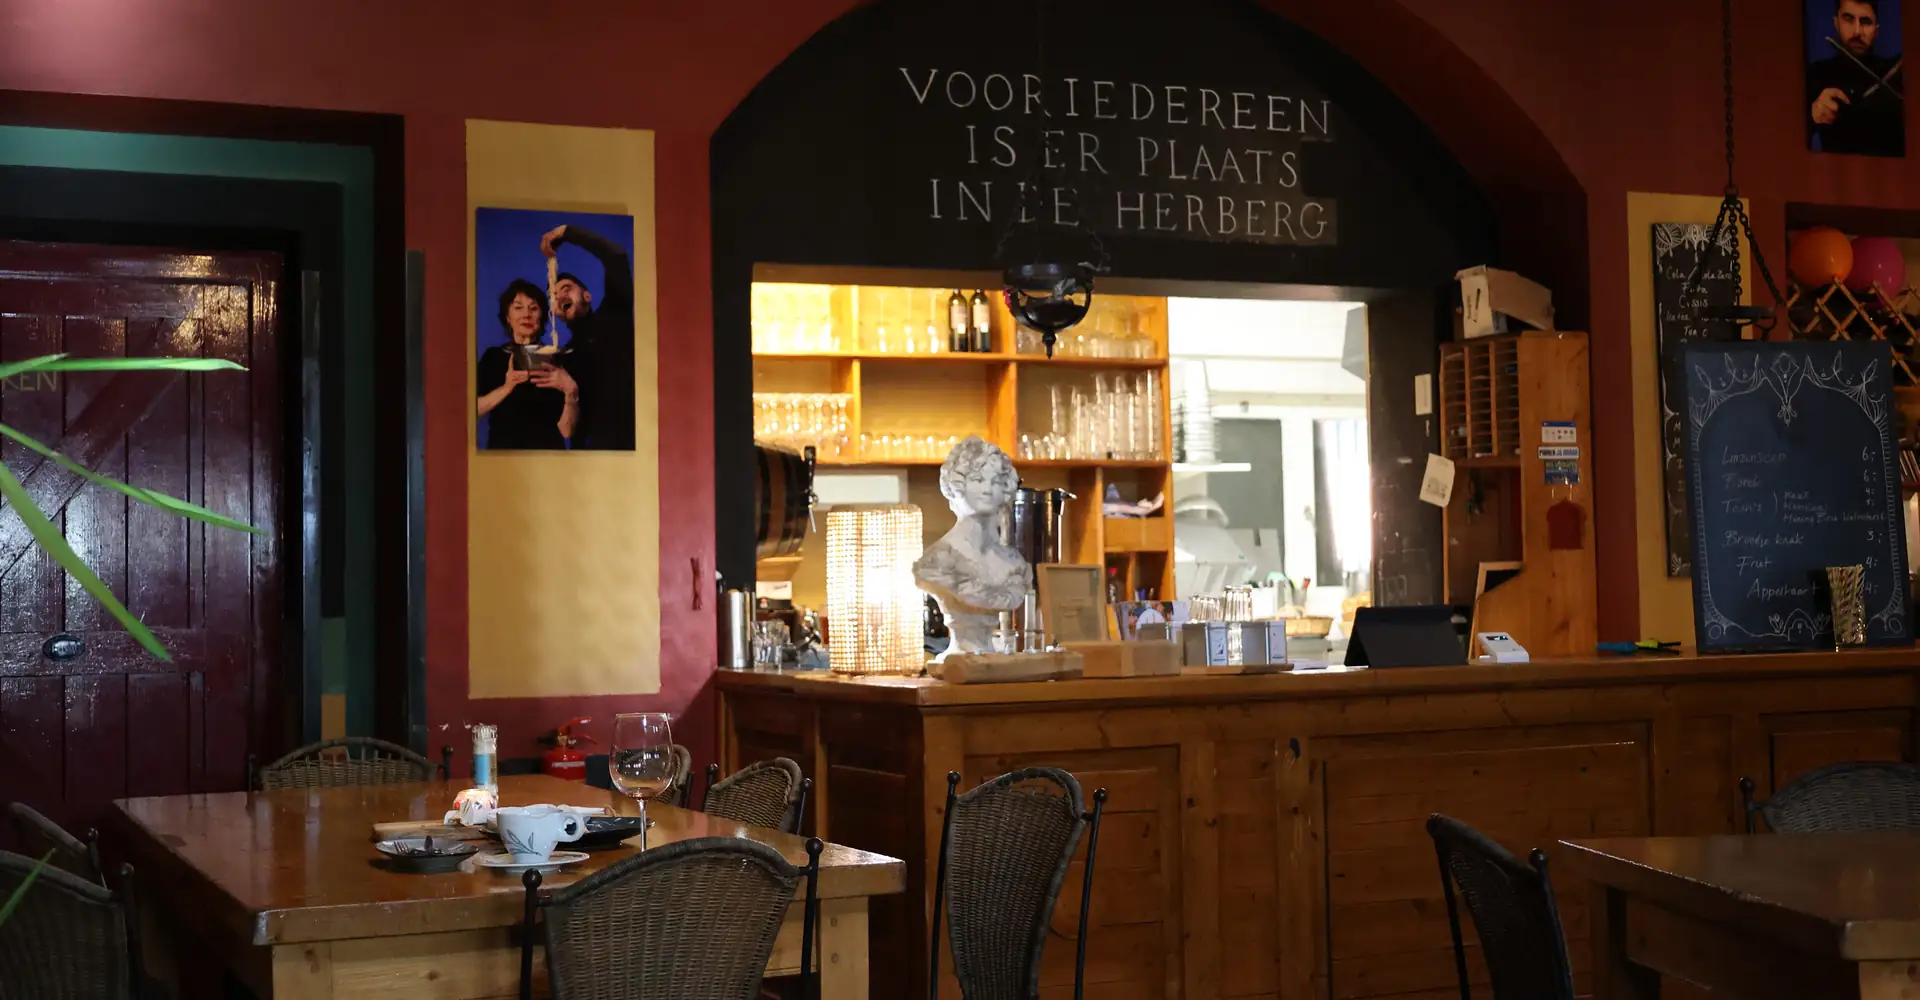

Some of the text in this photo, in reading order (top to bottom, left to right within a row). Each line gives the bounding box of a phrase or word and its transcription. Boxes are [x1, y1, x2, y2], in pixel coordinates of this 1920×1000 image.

[898, 67, 1332, 135] VOOR IEDEREEN
[965, 124, 1298, 188] IS ER PLAATS
[930, 178, 993, 223] IN
[1115, 191, 1328, 241] HERBERG
